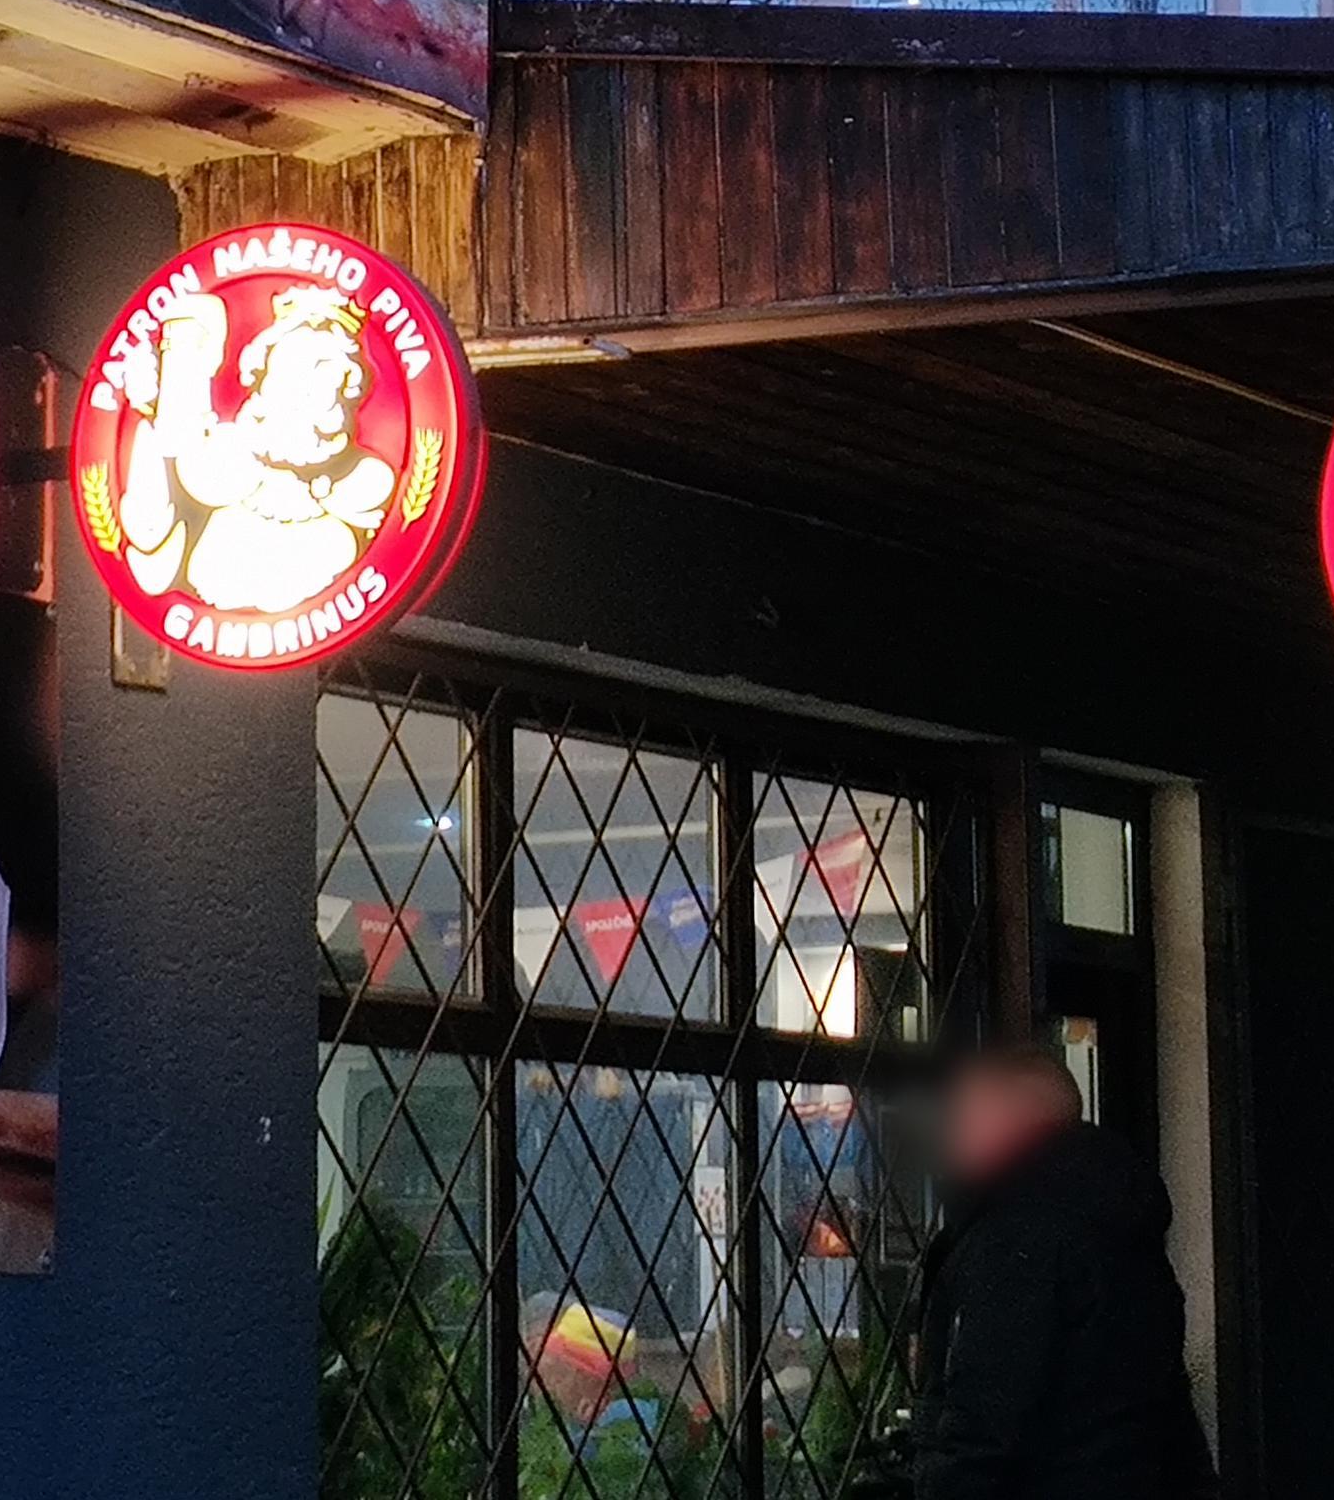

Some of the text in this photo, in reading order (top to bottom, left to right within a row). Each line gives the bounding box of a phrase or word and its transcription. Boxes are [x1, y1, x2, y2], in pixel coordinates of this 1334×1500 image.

[91, 229, 432, 411] PATRON NAŠEHO PIVA
[164, 566, 387, 659] GAMBRINUS
